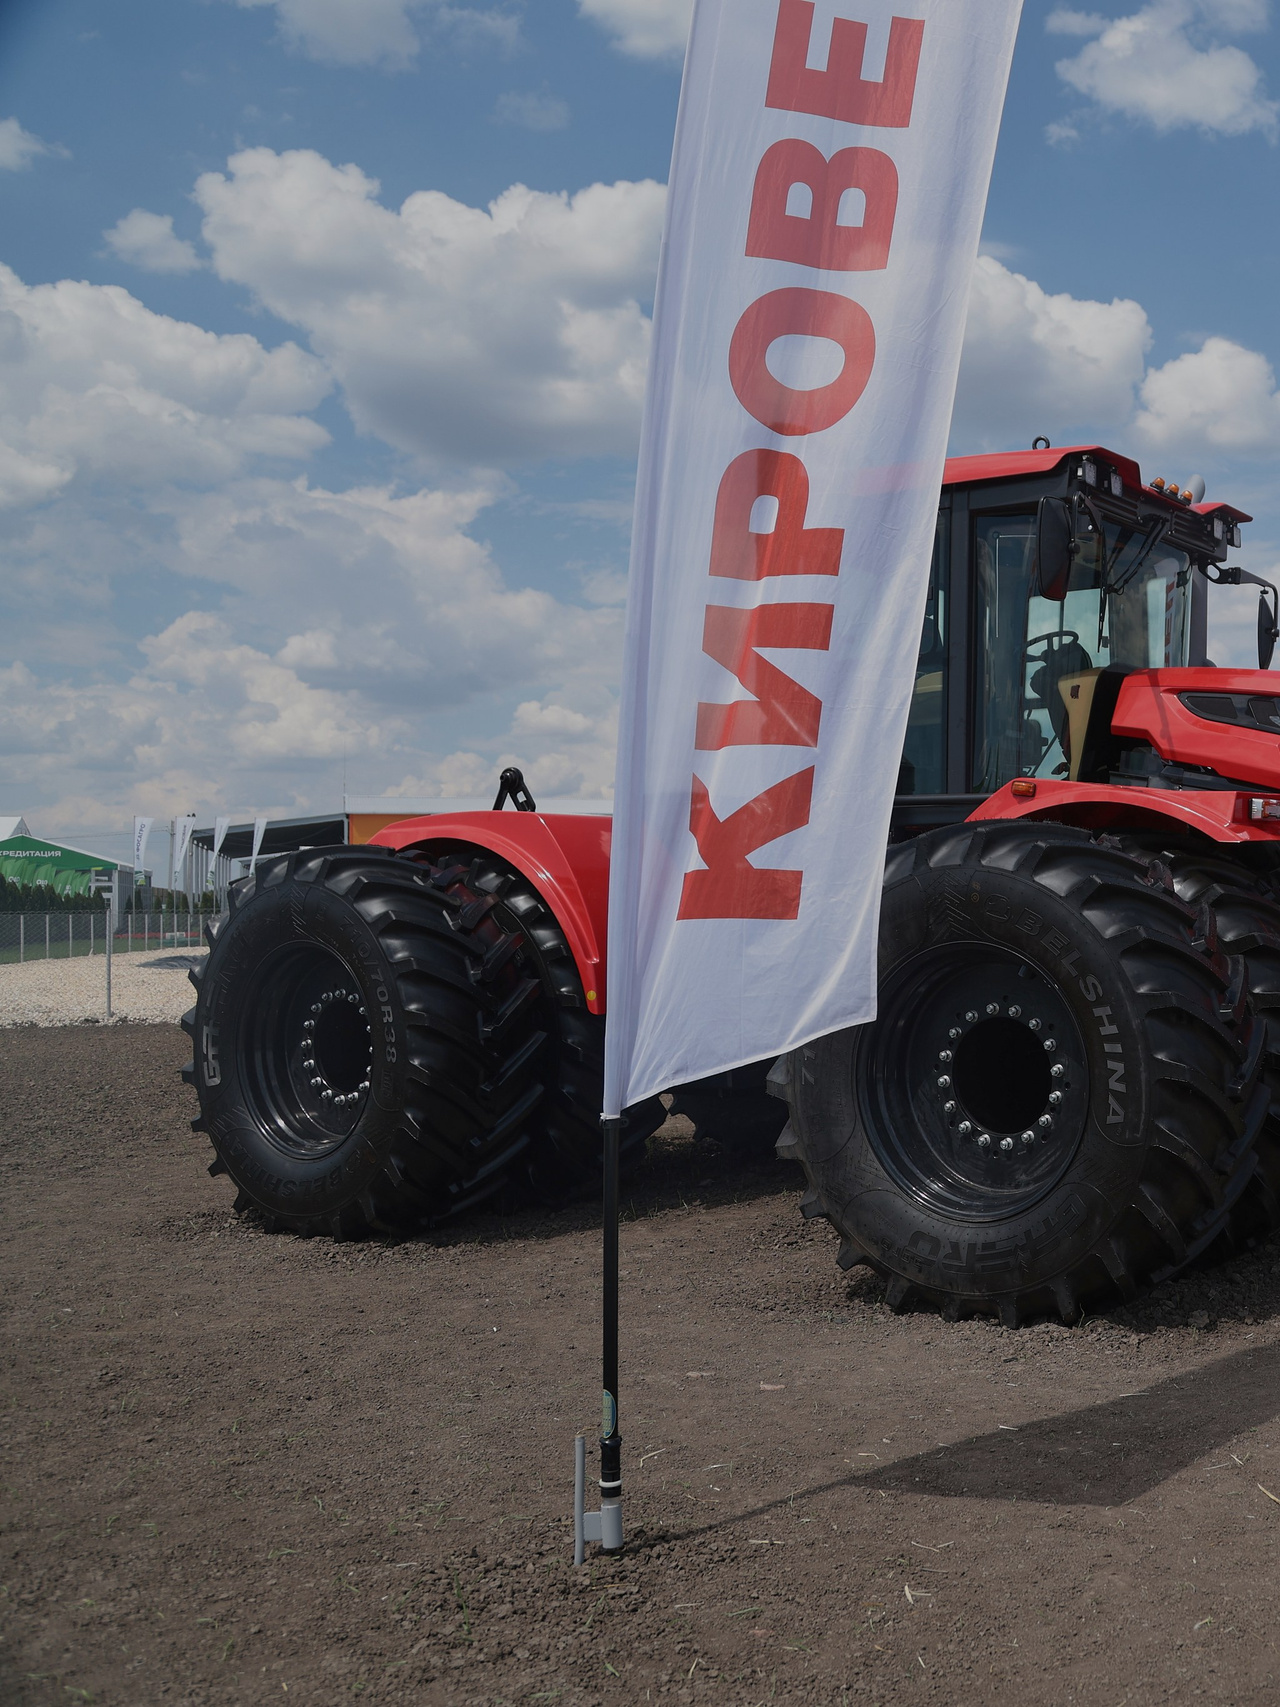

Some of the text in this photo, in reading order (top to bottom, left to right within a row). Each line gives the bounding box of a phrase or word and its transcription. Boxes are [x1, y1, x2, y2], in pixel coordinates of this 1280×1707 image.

[339, 915, 398, 1064] 710/70R38
[1014, 906, 1128, 1125] BELSHINA
[229, 1136, 343, 1198] BELSHINA
